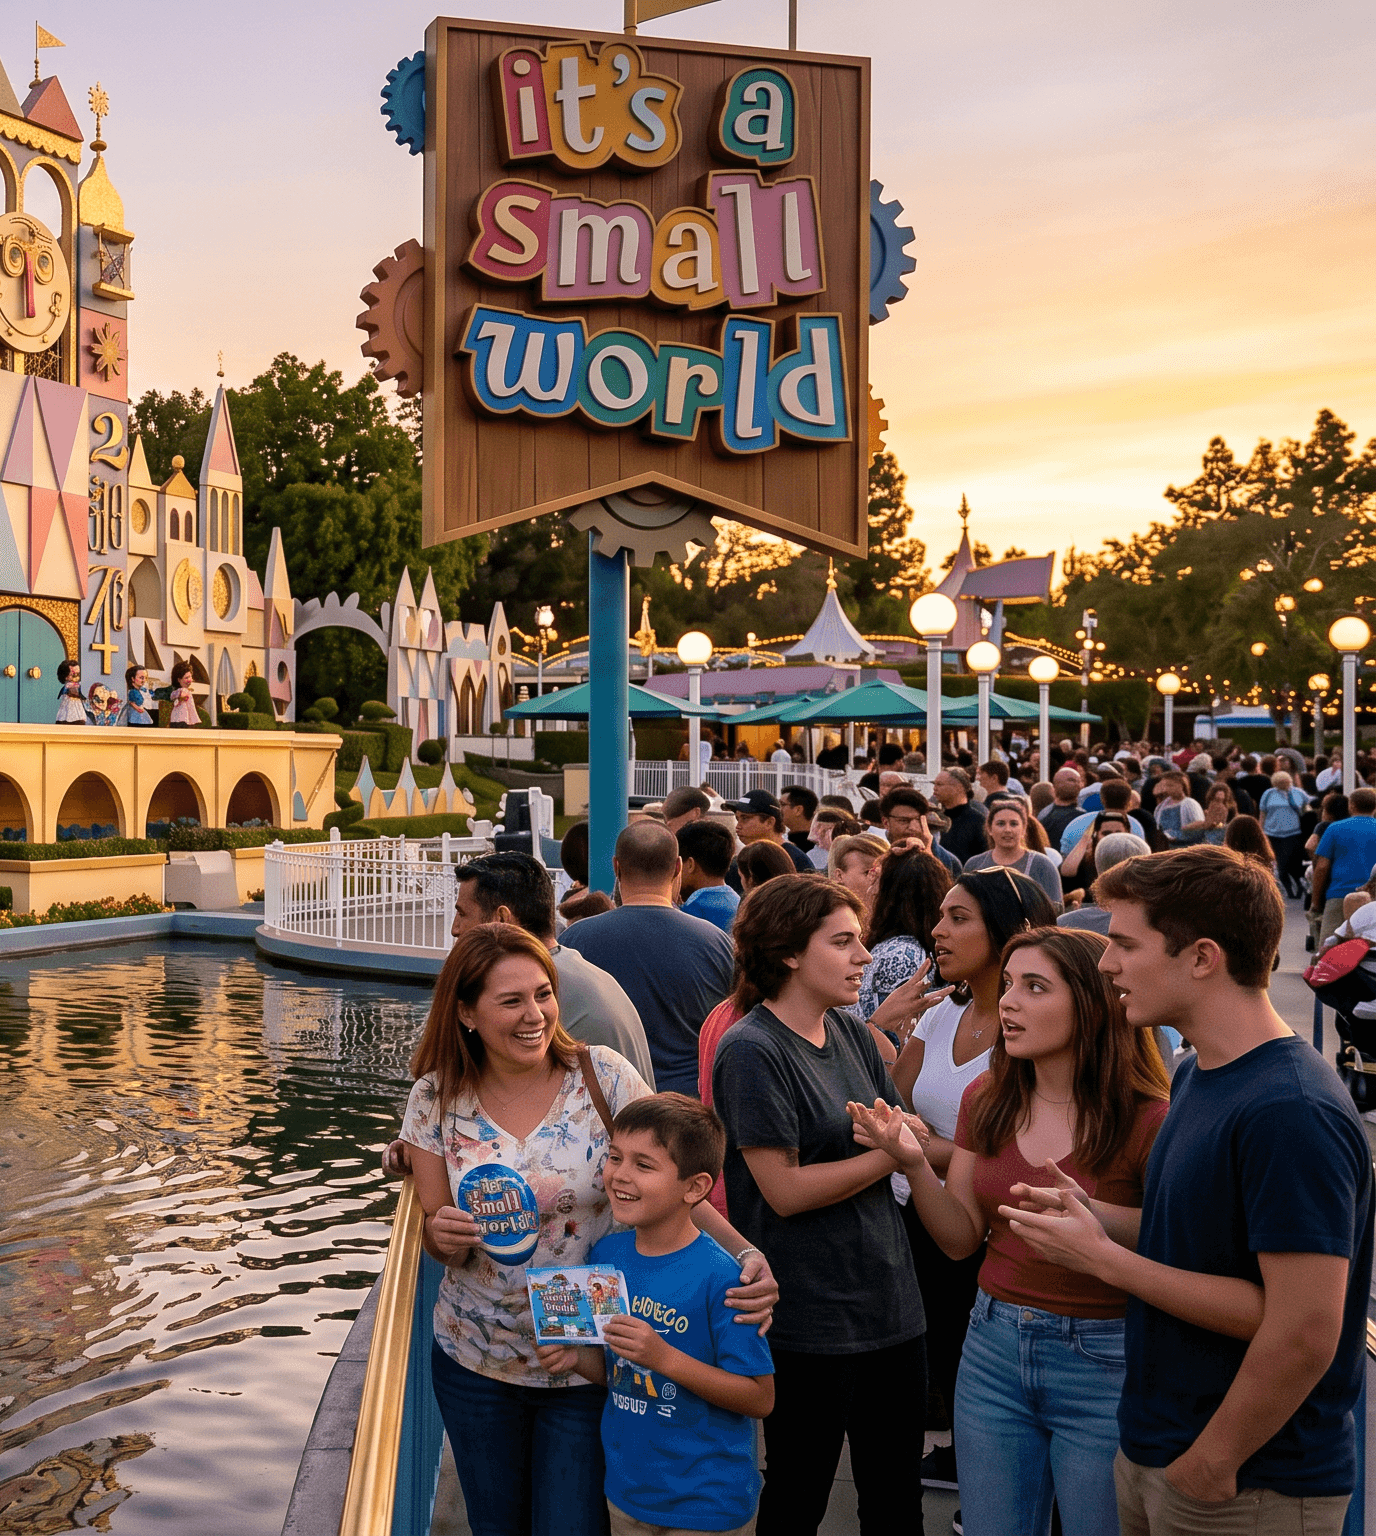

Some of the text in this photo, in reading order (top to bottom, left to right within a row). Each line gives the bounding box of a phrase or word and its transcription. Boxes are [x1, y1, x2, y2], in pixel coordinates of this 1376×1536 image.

[510, 54, 785, 154] it's a
[486, 183, 813, 295] small
[476, 321, 836, 439] world
[90, 411, 128, 471] 2
